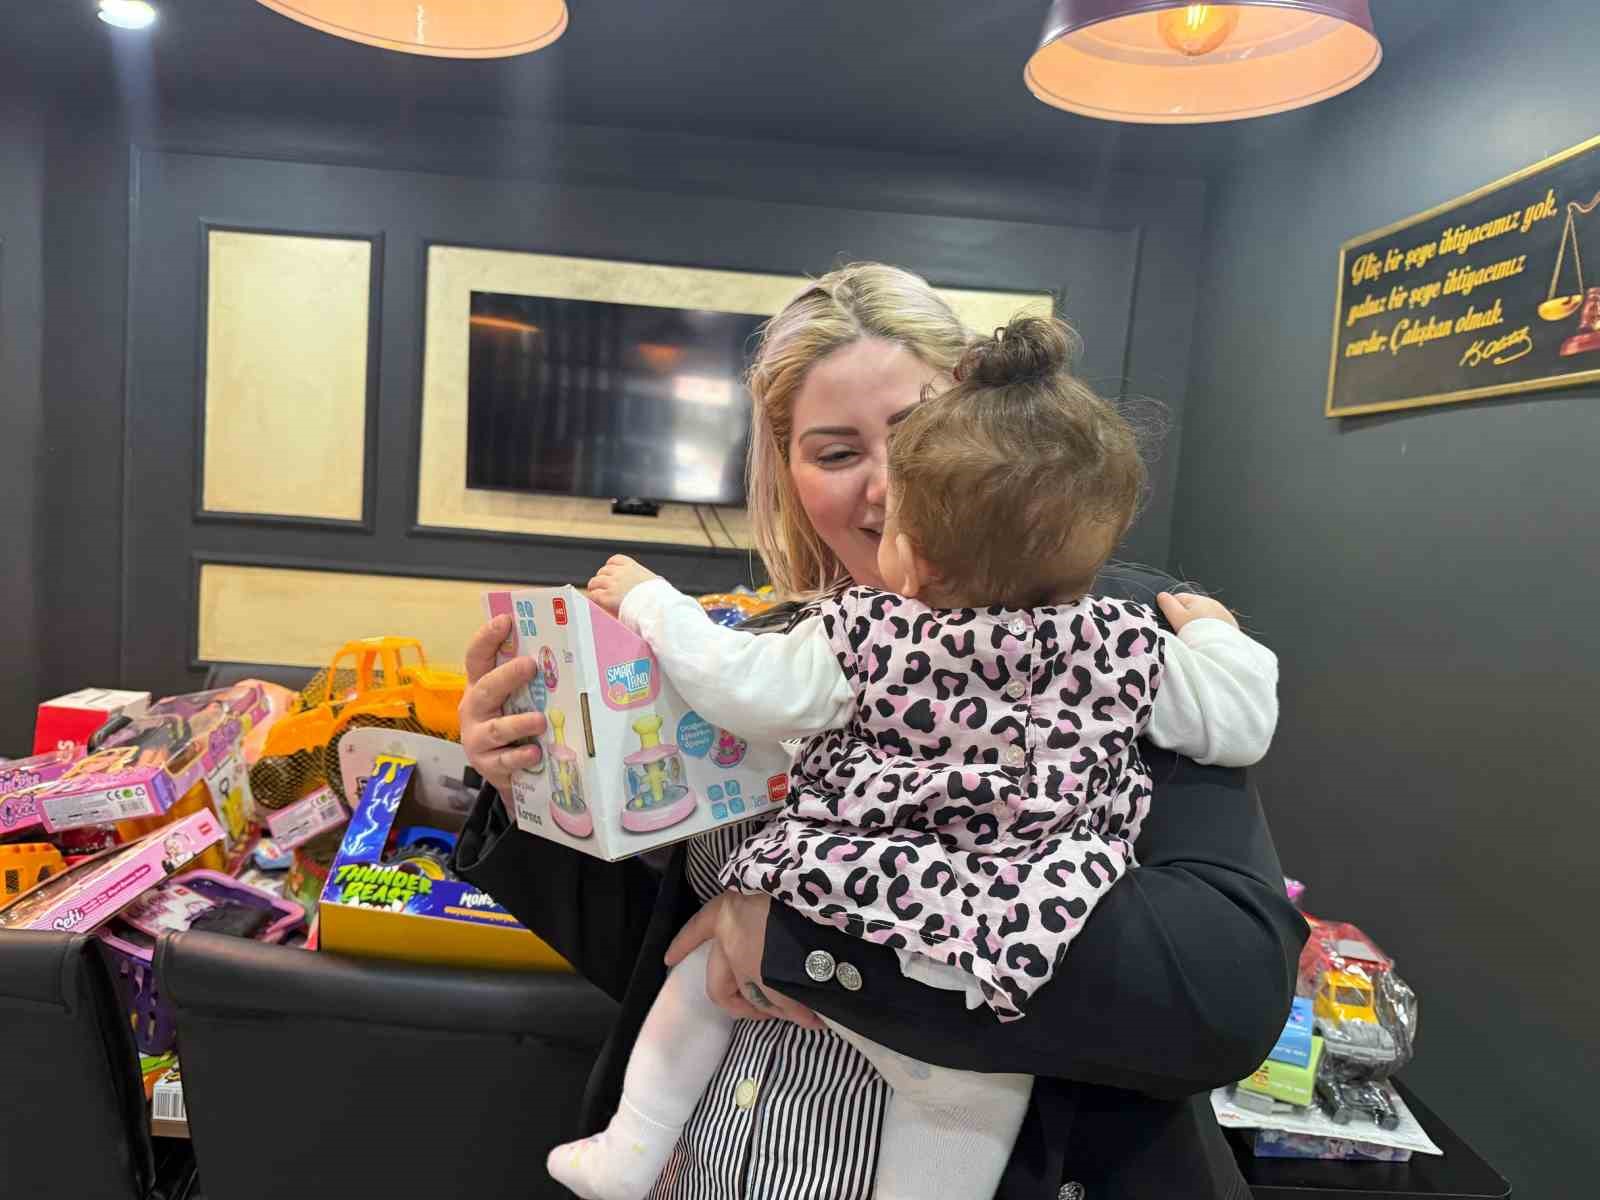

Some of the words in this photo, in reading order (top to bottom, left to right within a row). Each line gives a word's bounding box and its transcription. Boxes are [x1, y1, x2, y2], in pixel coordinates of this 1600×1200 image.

[1383, 248, 1405, 273] bir
[1404, 241, 1438, 271] şeye
[1438, 209, 1521, 256] ihtiyacımız
[1387, 285, 1409, 311] bir
[1408, 281, 1442, 309] şeye
[1442, 254, 1527, 297] ihtiyacımız
[334, 863, 433, 894] THUNDER
[341, 881, 416, 904] BEAST
